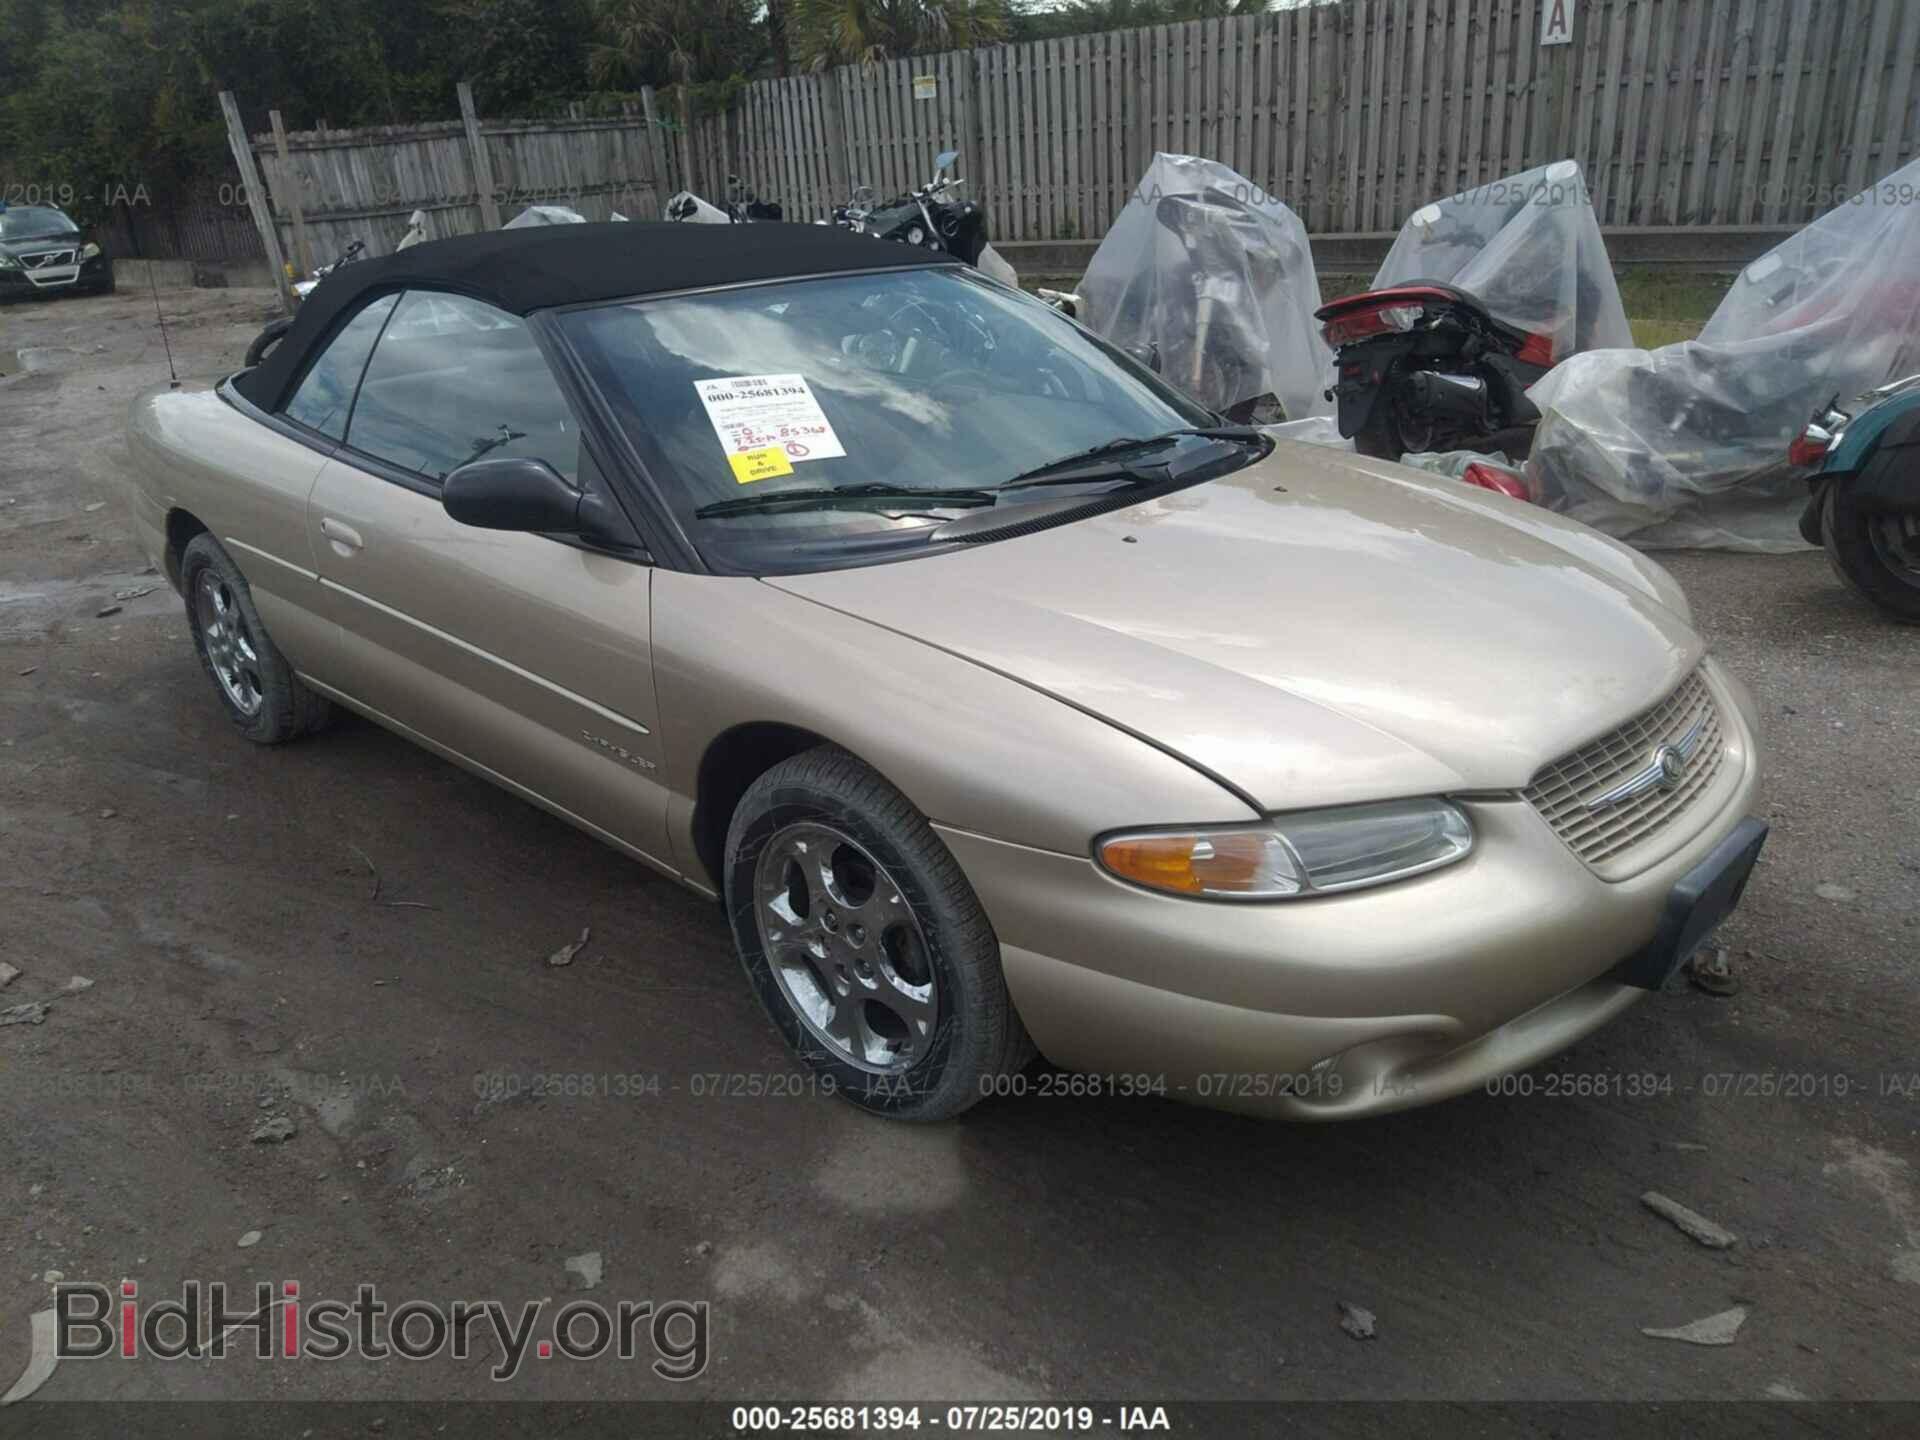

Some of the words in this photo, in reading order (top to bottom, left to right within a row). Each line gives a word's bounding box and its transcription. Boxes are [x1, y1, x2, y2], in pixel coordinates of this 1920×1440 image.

[1547, 0, 1566, 36] A
[706, 387, 806, 402] 000-25681394
[750, 465, 777, 475] DRIVE
